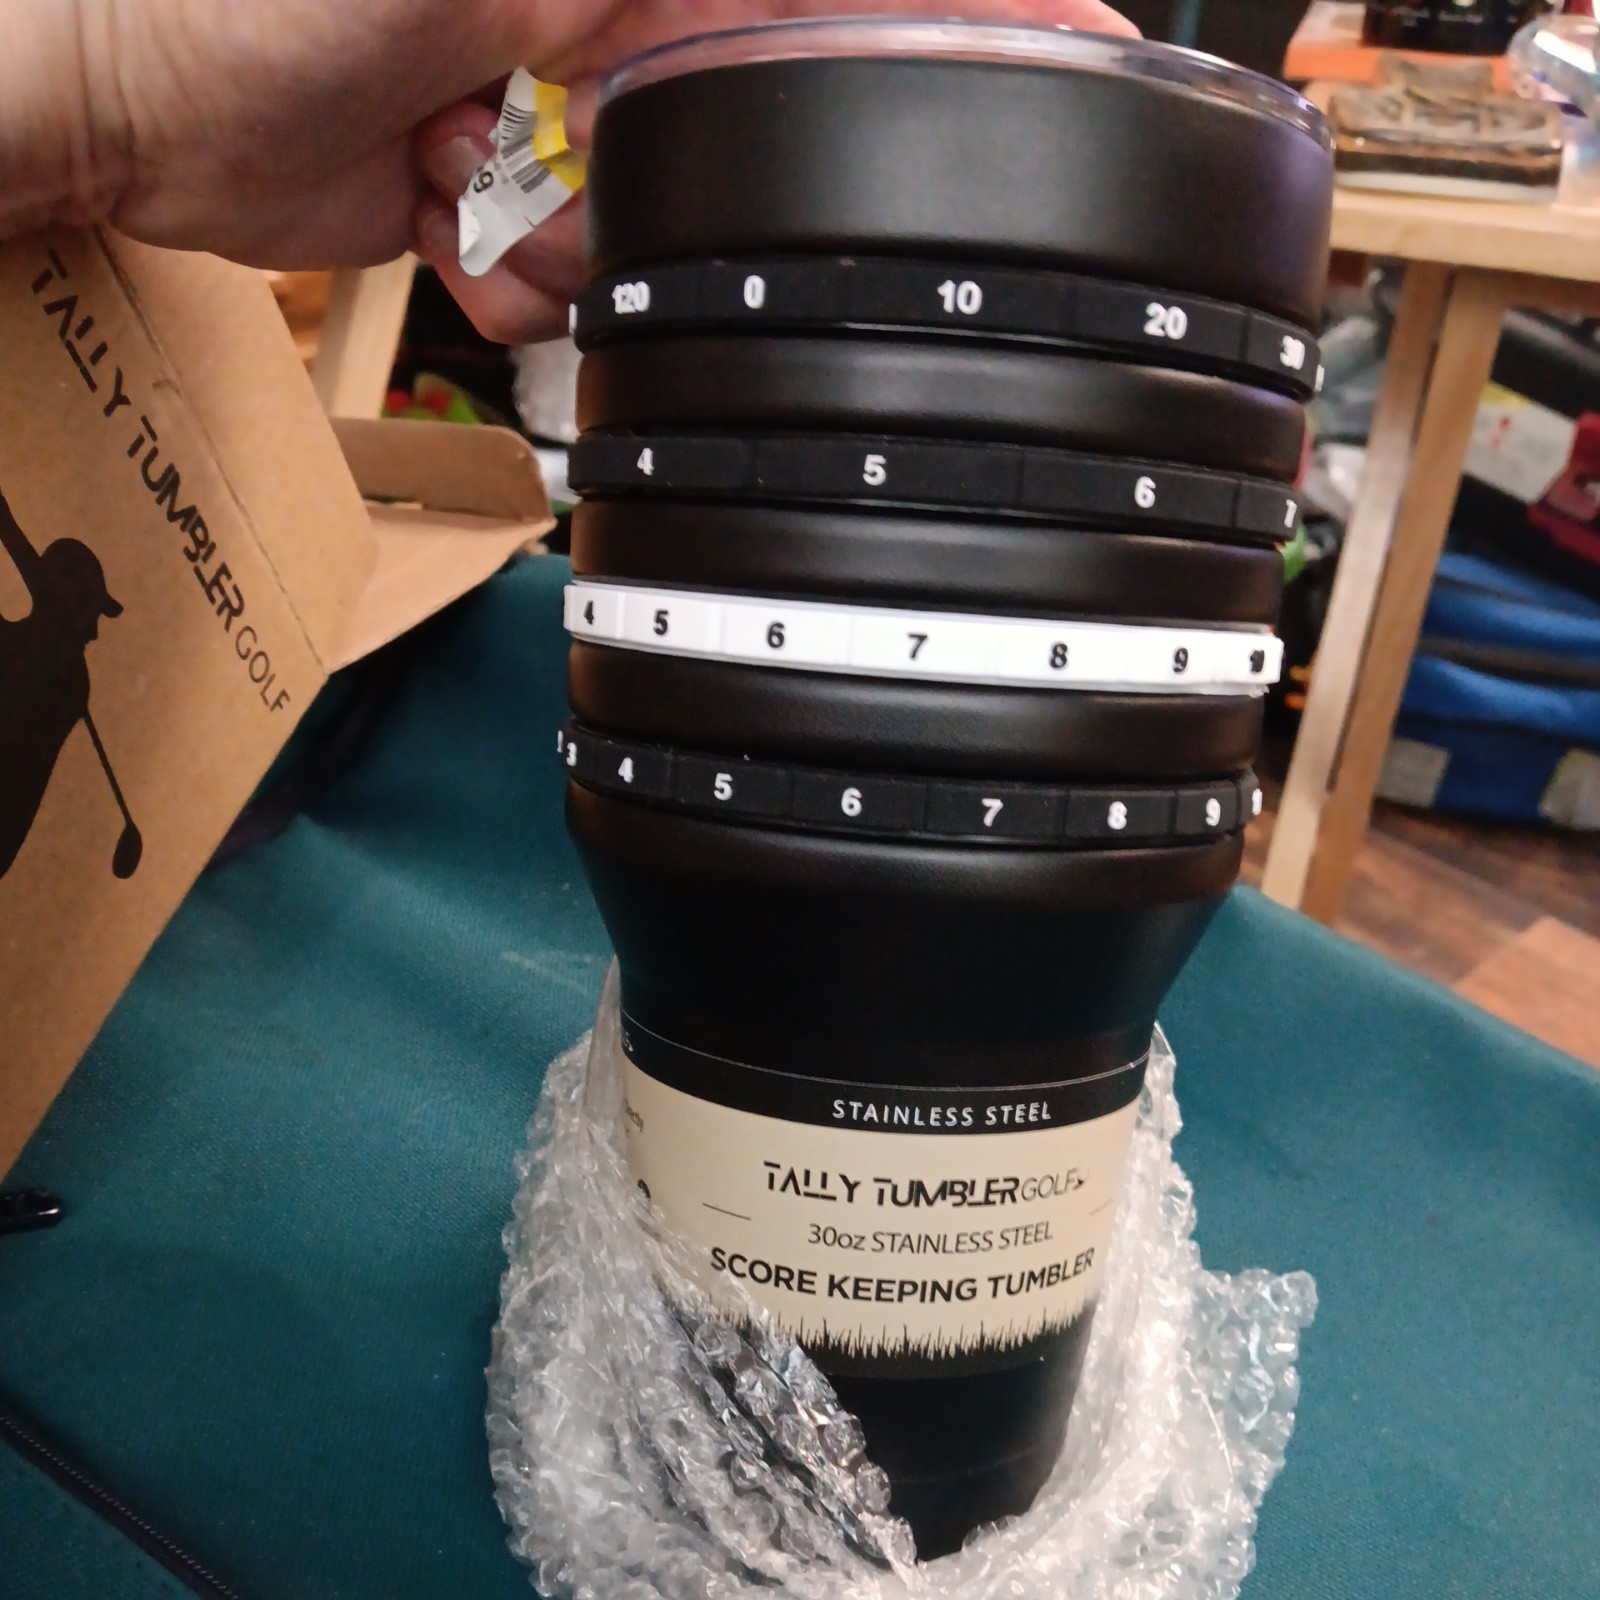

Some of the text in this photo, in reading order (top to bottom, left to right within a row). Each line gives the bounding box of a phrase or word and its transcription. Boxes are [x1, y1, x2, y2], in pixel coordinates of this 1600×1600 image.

[31, 248, 132, 418] TALLY
[743, 274, 766, 310] 0
[937, 279, 984, 316] 10
[1143, 302, 1188, 340] 20
[636, 447, 654, 477] 4
[862, 453, 887, 487] 5
[1134, 476, 1157, 509] 6
[583, 600, 595, 626] 4
[653, 609, 670, 637] 5
[766, 622, 786, 650] 6
[907, 632, 929, 661] 7
[1049, 642, 1069, 670] 8
[1172, 646, 1190, 675] 9
[617, 756, 635, 784] 4
[713, 772, 734, 801] 5
[840, 786, 863, 818] 6
[981, 797, 1004, 828] 7
[1106, 801, 1128, 831] 8
[1205, 797, 1222, 828] 9
[832, 1098, 1053, 1128] STAINLESS STEEL
[763, 1159, 862, 1204] TALLY
[807, 1220, 1055, 1255] 30oz STAINLESS STEEL
[710, 1246, 1096, 1304] SCORE KEEPING TUMBLER
